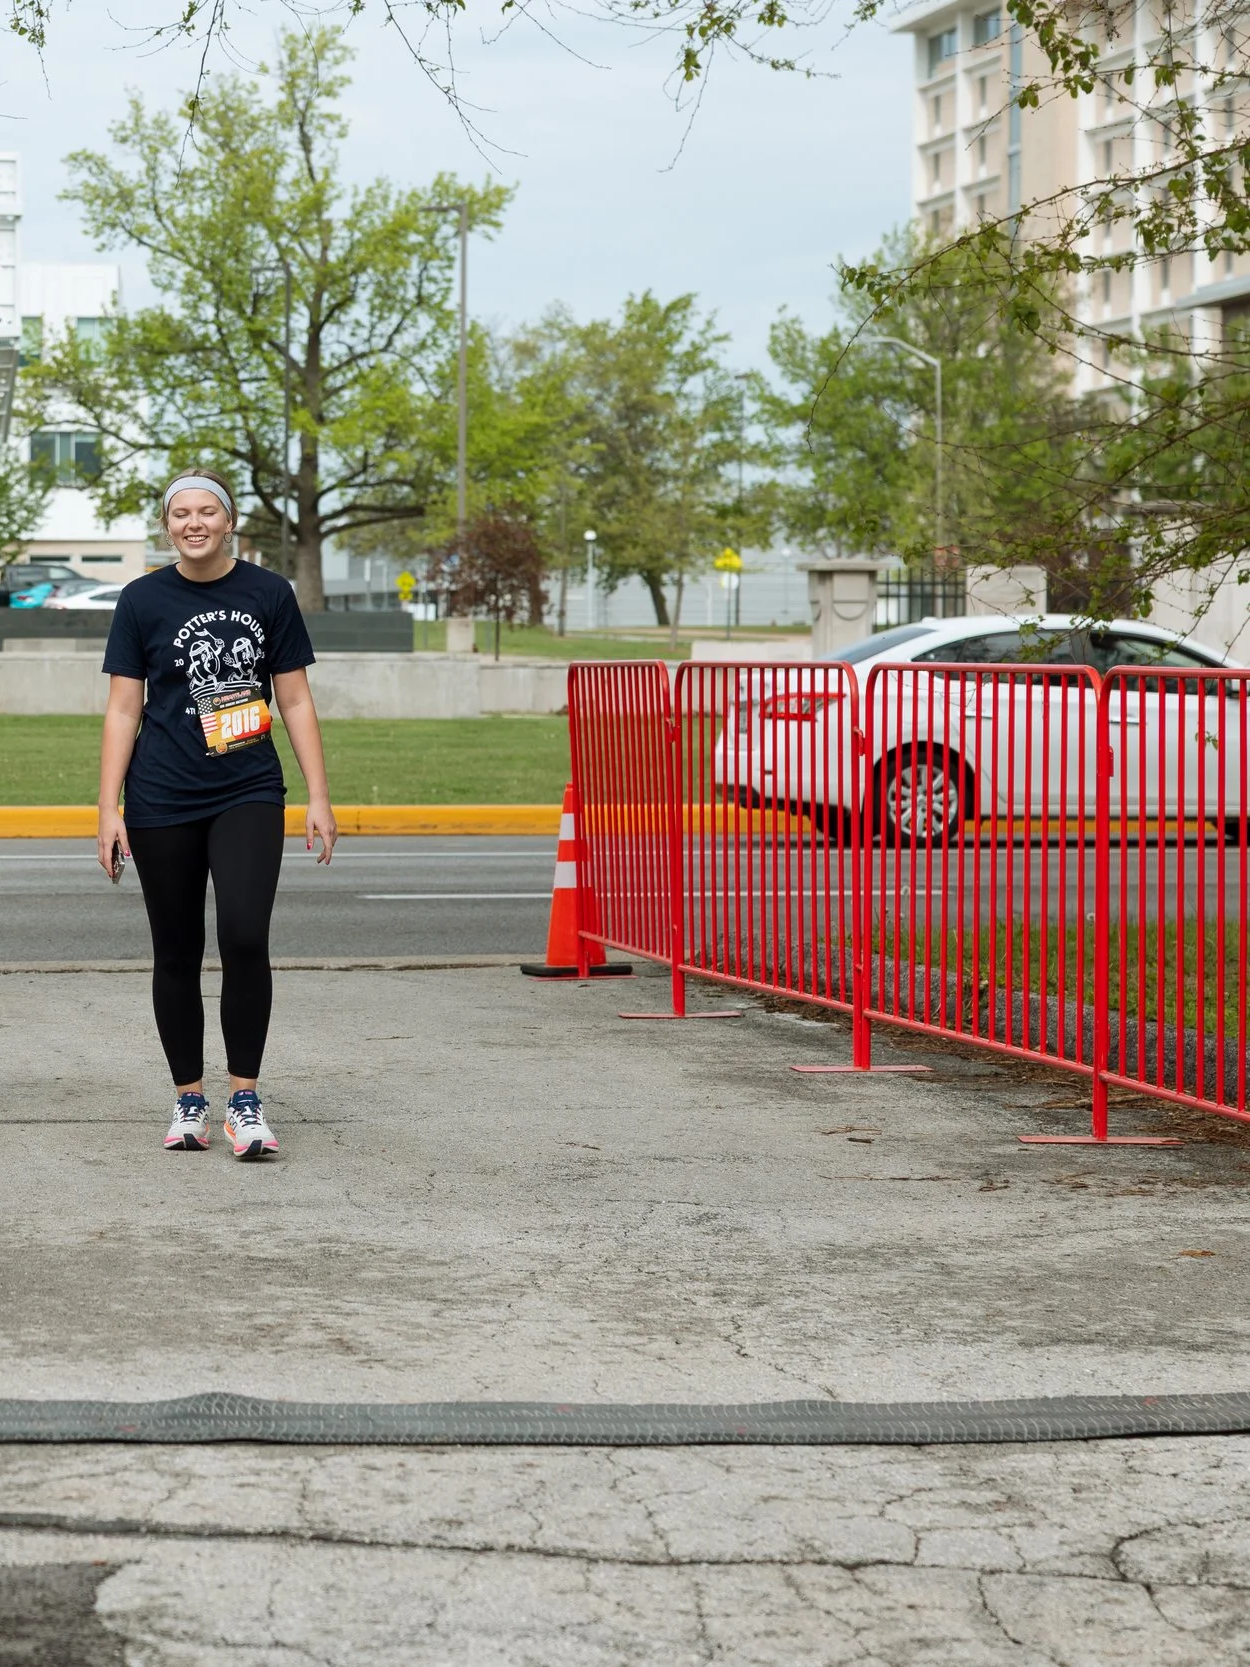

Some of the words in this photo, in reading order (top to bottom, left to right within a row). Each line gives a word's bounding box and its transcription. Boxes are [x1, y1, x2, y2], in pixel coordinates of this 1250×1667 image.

[173, 610, 227, 648] POTTER'S
[231, 610, 265, 644] HOUSE
[174, 658, 184, 667] 20
[220, 706, 260, 739] 2016
